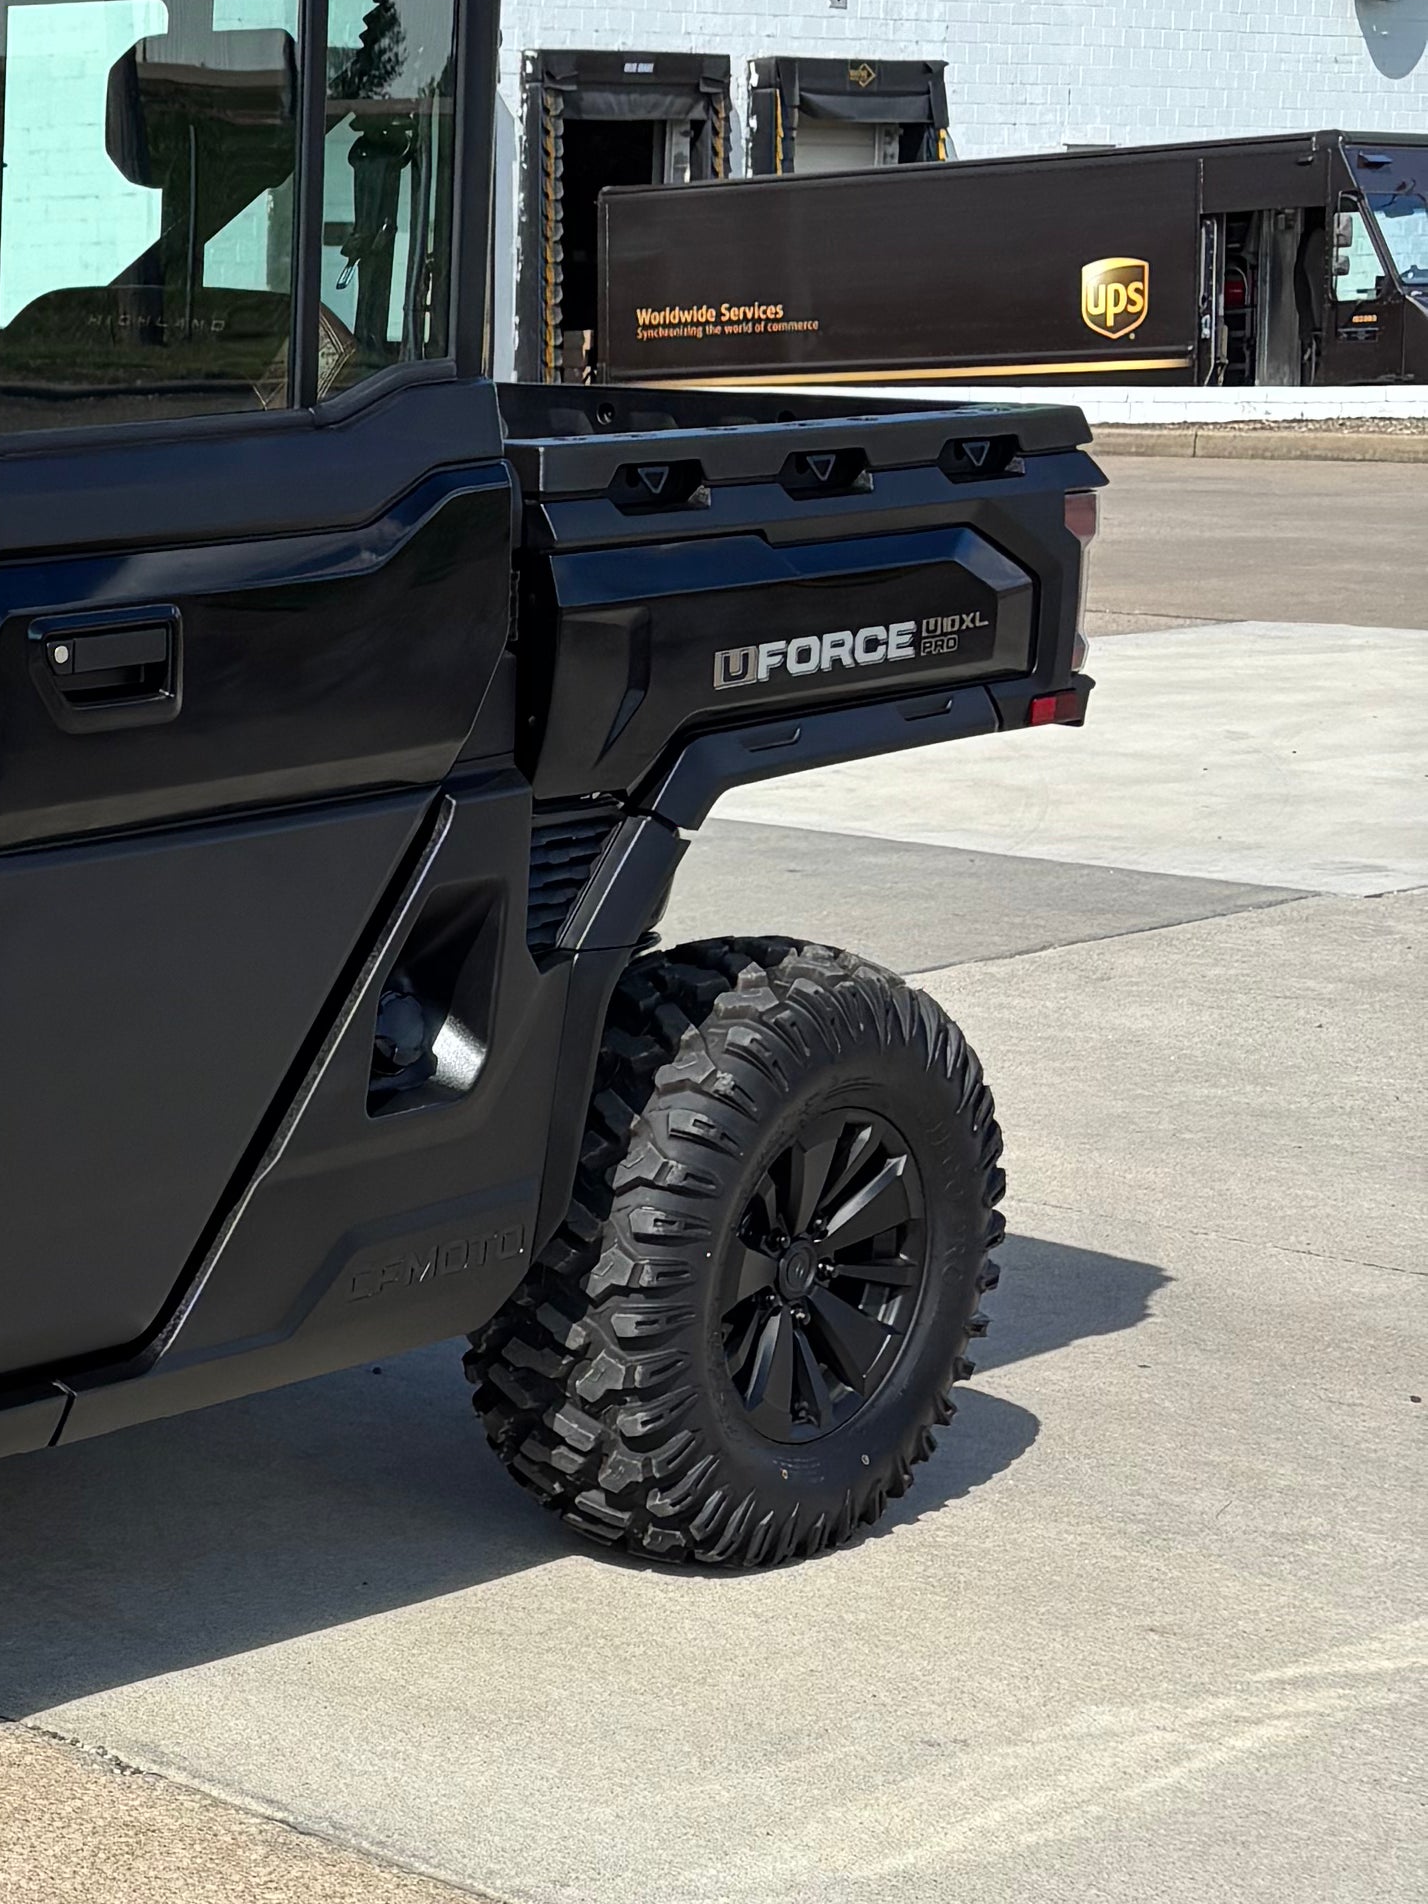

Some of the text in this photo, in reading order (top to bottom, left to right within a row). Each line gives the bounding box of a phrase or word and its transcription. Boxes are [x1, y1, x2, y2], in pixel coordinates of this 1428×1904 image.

[636, 302, 784, 326] Worldwide Services
[1087, 281, 1144, 327] ups
[87, 313, 225, 333] HIGHLAND
[705, 323, 721, 335] the
[724, 322, 753, 335] world
[755, 321, 765, 333] of
[767, 320, 819, 333] commerce
[713, 620, 917, 691] UFORCE
[920, 635, 958, 656] PRO
[347, 1224, 526, 1304] CFMOTO
